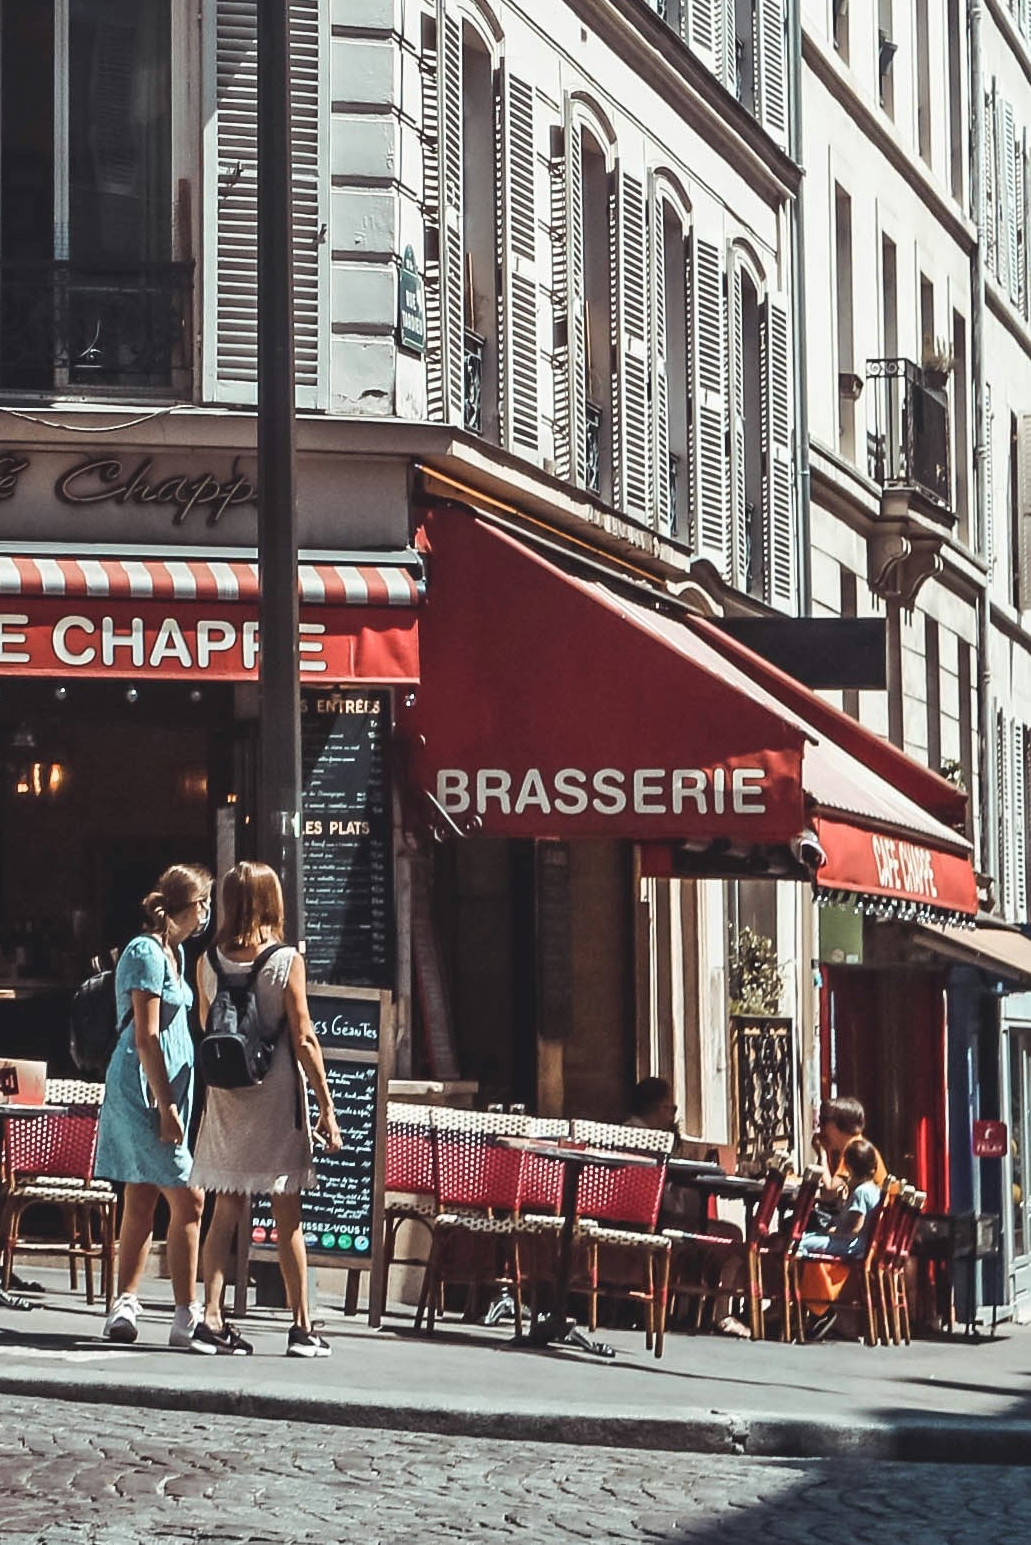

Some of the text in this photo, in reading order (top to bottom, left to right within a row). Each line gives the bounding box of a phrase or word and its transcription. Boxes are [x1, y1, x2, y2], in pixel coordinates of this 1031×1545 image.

[55, 458, 258, 525] Chapp
[436, 768, 767, 815] BRASSERIE
[329, 821, 371, 835] PLATS
[872, 834, 901, 891] CAFE
